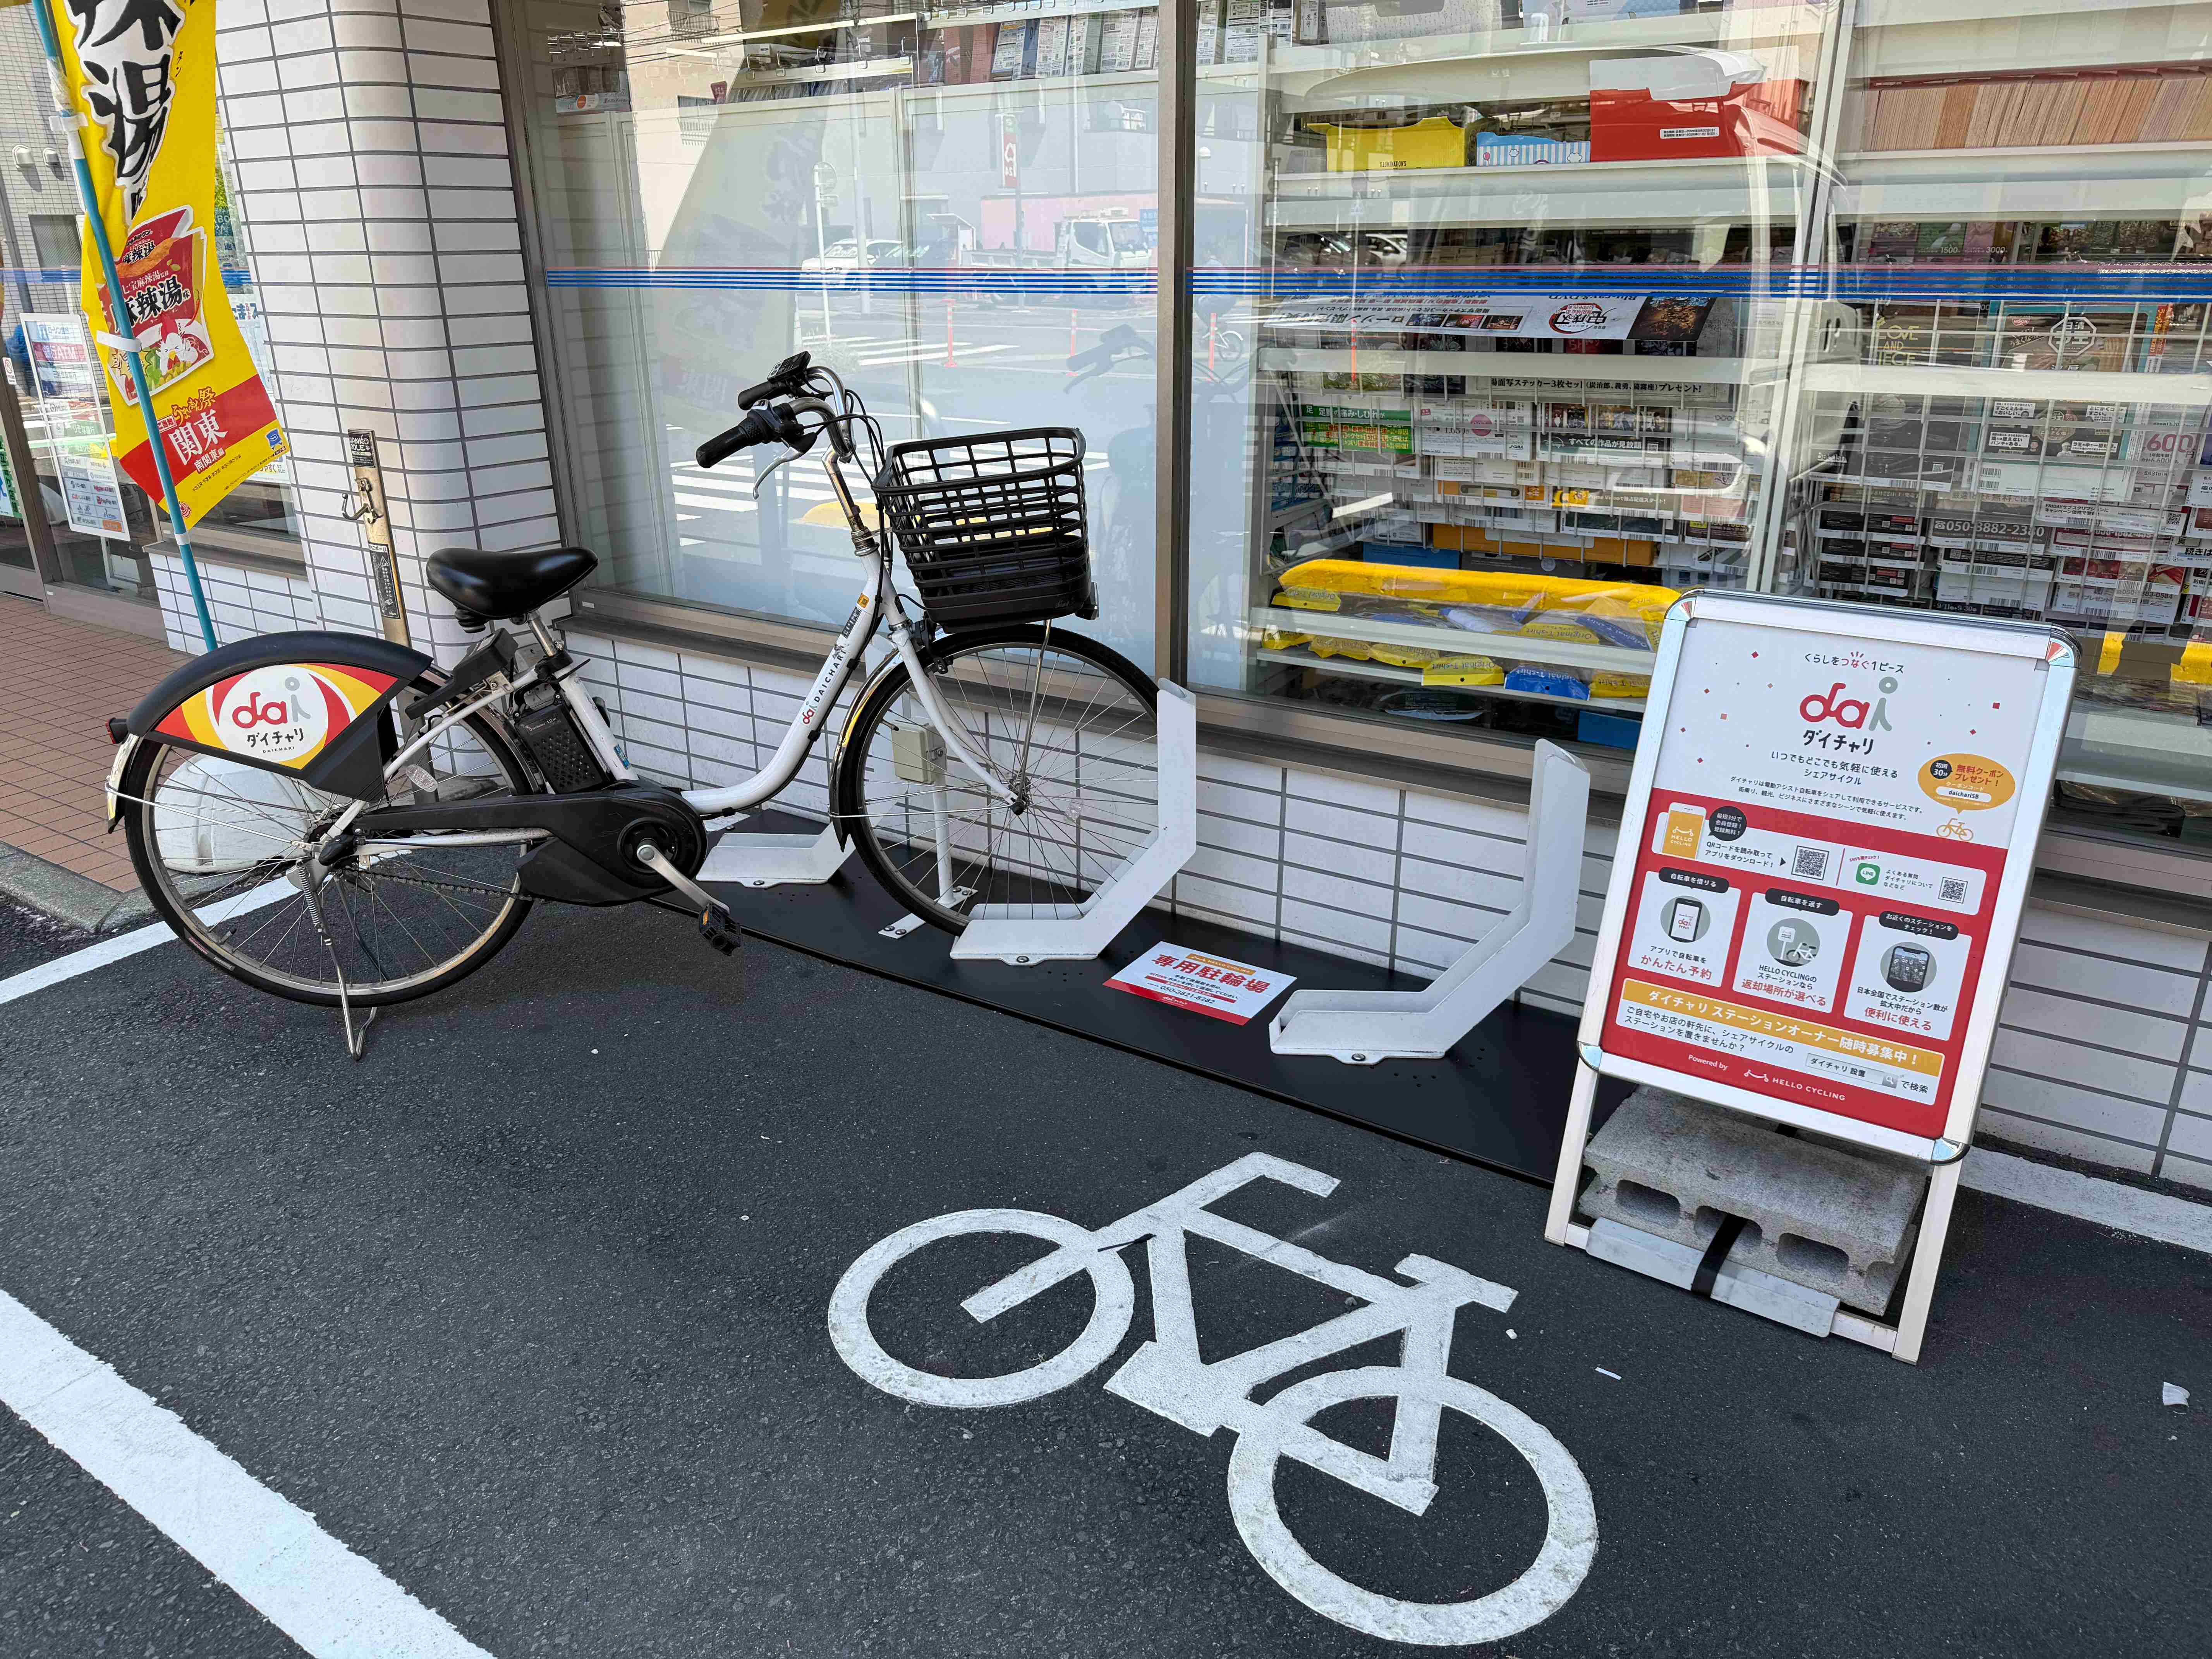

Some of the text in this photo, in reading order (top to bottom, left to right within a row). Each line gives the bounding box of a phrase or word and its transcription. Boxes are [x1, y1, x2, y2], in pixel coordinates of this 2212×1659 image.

[1884, 341, 1904, 350] AND
[169, 409, 228, 465] 関東
[1526, 628, 1592, 639] Original T-shirt
[1615, 629, 1647, 648] Original
[1462, 660, 1494, 670] Original
[1515, 667, 1546, 678] T-shirt
[1804, 653, 1905, 674] くらしをつなぐ1ピース
[814, 649, 846, 702] DAICHARI
[233, 677, 311, 728] dai
[1800, 677, 1898, 732] dai
[247, 728, 304, 748] ダイチャリ
[1803, 729, 1874, 755] ダイチャリ
[1771, 751, 1898, 778] いつでもどこでも気軽に使える
[1933, 769, 1948, 777] 30分
[1956, 764, 2004, 778] 無料クーポン
[1804, 769, 1862, 785] シェアサイクル
[1946, 781, 1985, 791] クーポンコード
[1730, 776, 1923, 814] ダイチャリは電動アシスト自転車をシェアして利用できるサービスです。
[1738, 787, 1907, 820] 街乗り、観光、ビジネスにさまざまなシーンで気軽に使えます。
[1948, 790, 1979, 799] daichariSB
[1716, 812, 1743, 823] 最短3分で
[1706, 841, 1773, 859] QRコードを読み取って
[1670, 873, 1717, 888] 自転車を借りる
[1884, 876, 1934, 889] ダイチャリについて
[1885, 869, 1919, 880] よくある質問
[1883, 882, 1905, 891] などなど
[1781, 895, 1823, 909] 自転車を返す
[1885, 913, 1953, 932] お近くのステーションを
[1650, 945, 1707, 964] アプリで自転車を
[1152, 954, 1271, 993] 専用駐輪場
[1640, 955, 1712, 981] かんたん予約
[1759, 964, 1817, 983] HELLO CYCLINGの
[1757, 972, 1813, 990] ステーションなら
[1160, 985, 1216, 1005] 050-3821-8282
[1741, 978, 1826, 1006] 返却場所が選べる
[1857, 986, 1948, 1012] 日本全国でステーション数が
[1879, 1000, 1922, 1015] 拡大中だから
[1864, 1007, 1932, 1031] 便利に使える
[1624, 1015, 1745, 1052] ステーションを置きませんか？
[1627, 1006, 1794, 1054] ご自宅やお店の軒先に、シェアサイクルの
[1688, 1054, 1729, 1071] Powered by
[1810, 1058, 1866, 1078] ダイチャリ 設置
[1772, 1077, 1846, 1102] HELLO CYCLING
[1901, 1080, 1929, 1094] で検索
